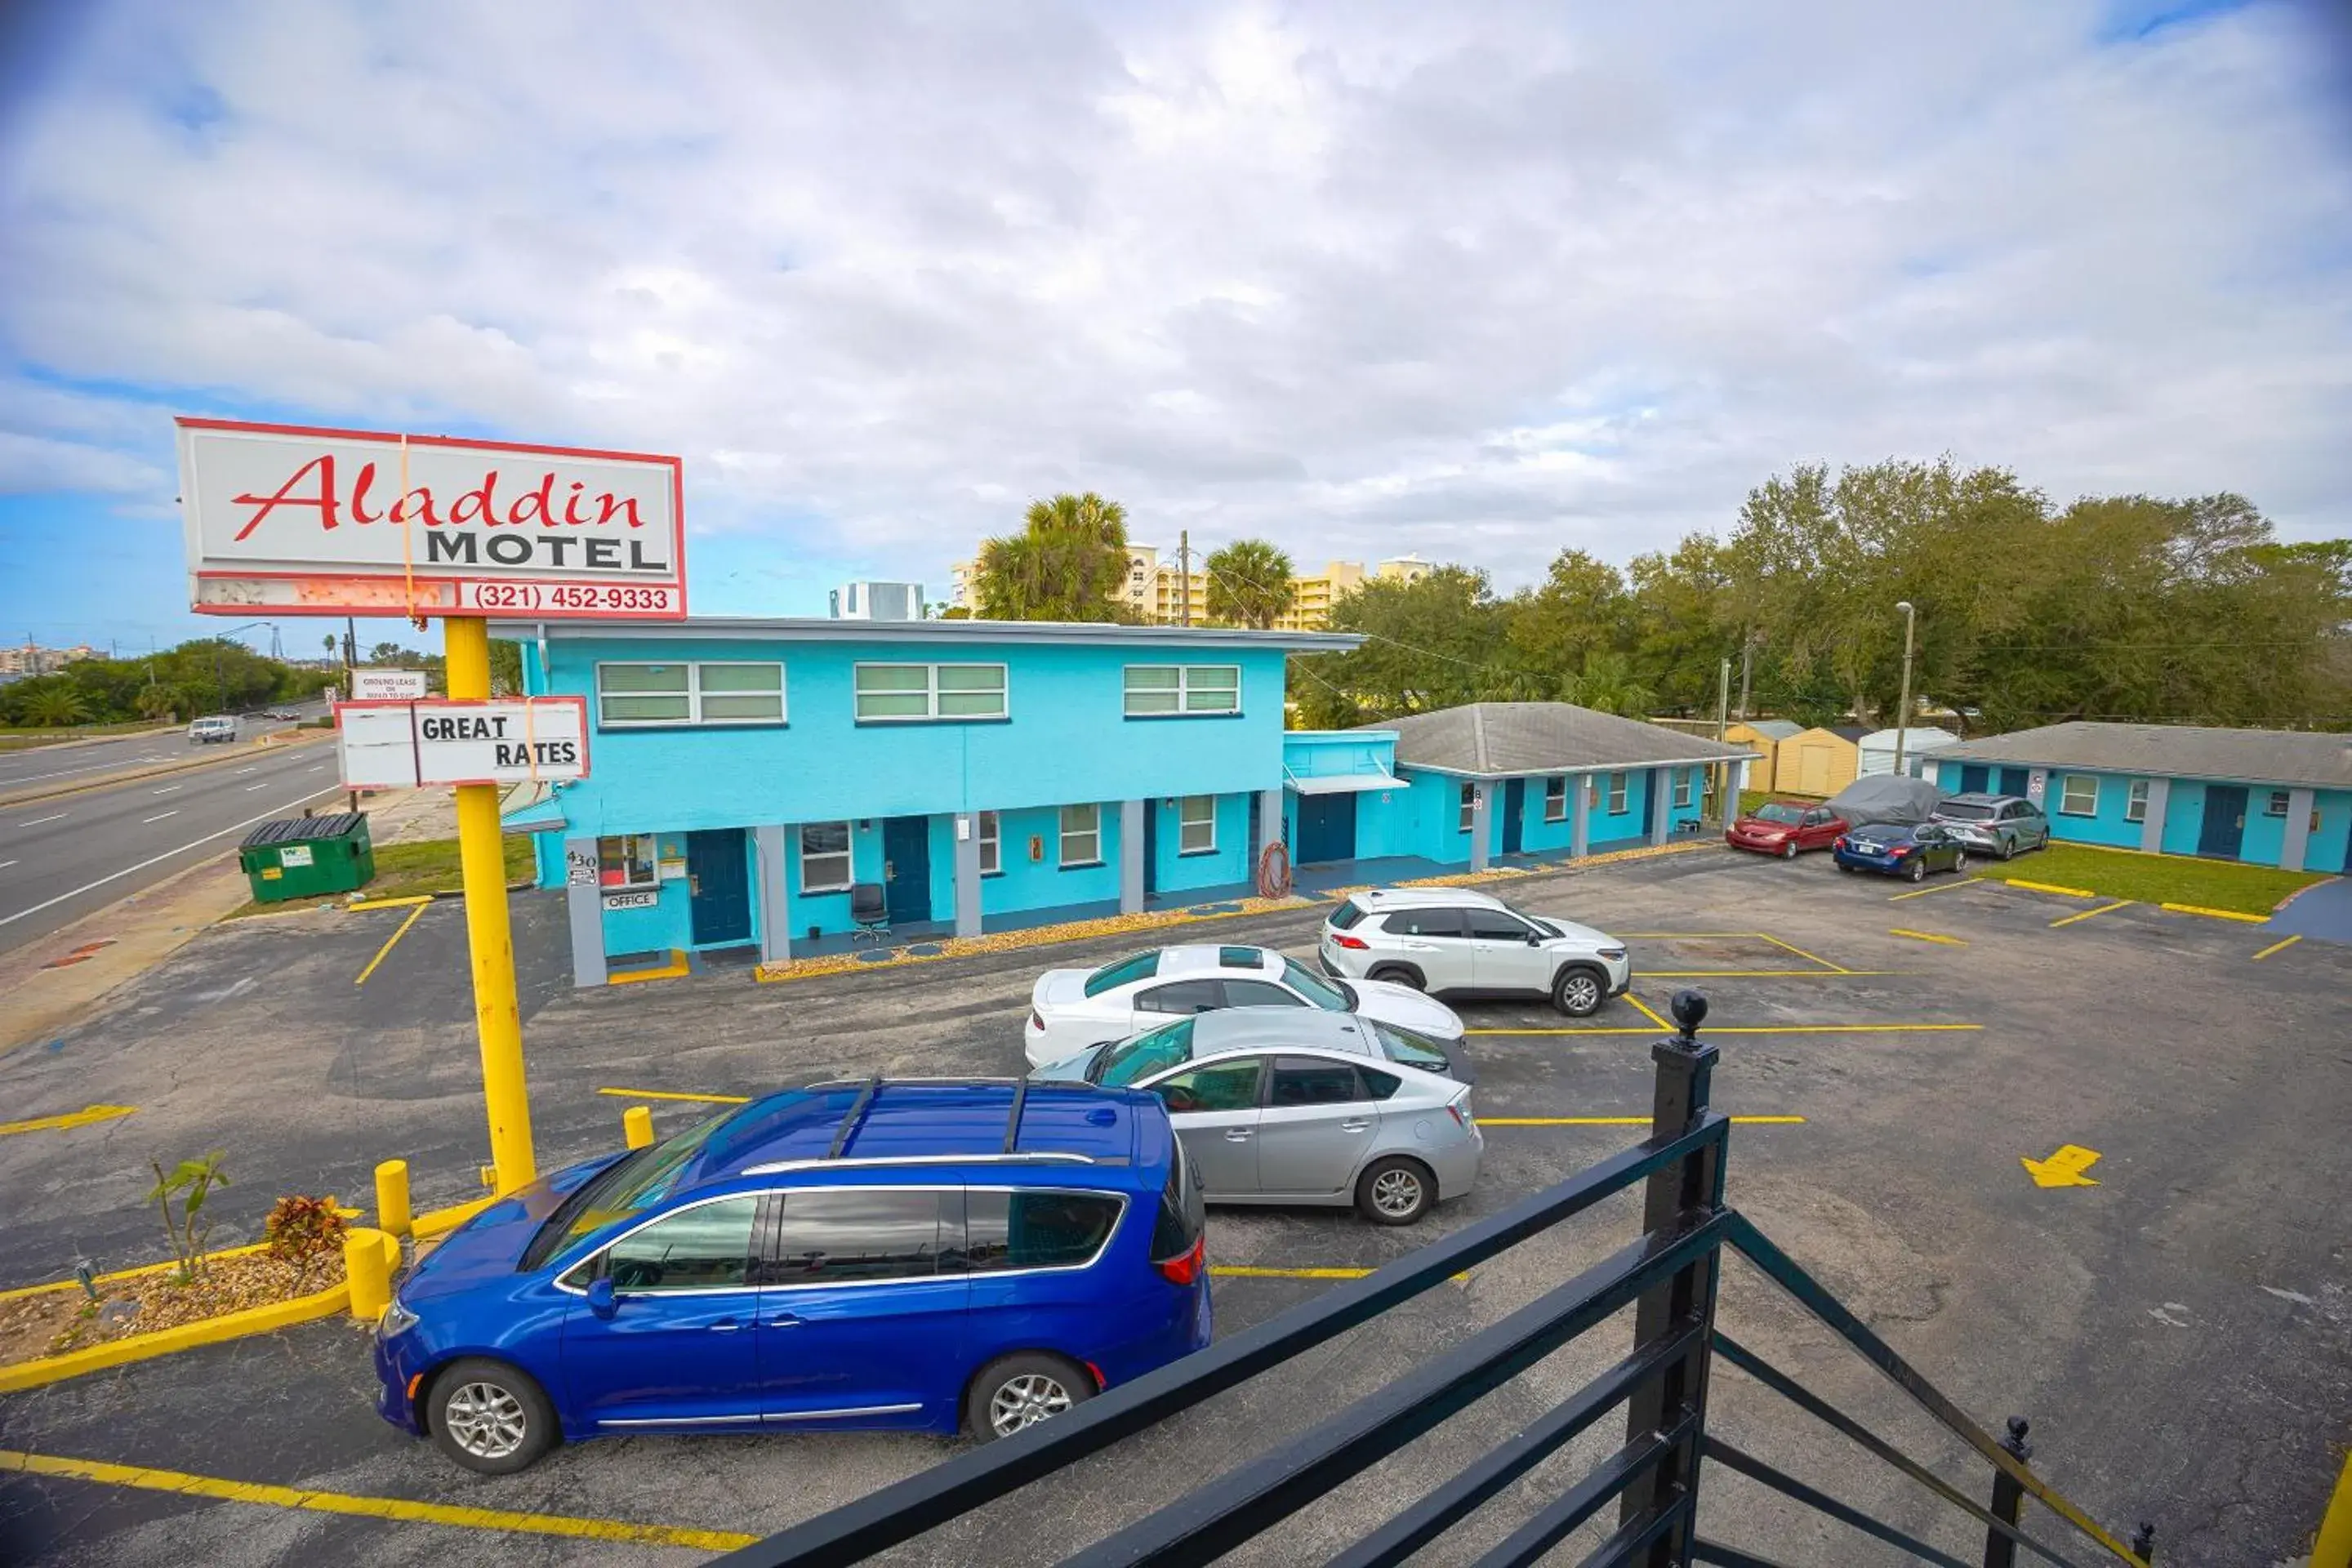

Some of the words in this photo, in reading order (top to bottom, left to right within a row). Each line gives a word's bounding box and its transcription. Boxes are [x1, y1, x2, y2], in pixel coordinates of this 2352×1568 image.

[230, 454, 644, 541] Aladdin
[427, 530, 667, 571] MOTEL
[475, 585, 541, 609] (321)
[551, 587, 668, 610] 452-9333
[422, 716, 507, 739] GREAT
[496, 742, 577, 765] RATES
[609, 893, 650, 907] OFFICE
